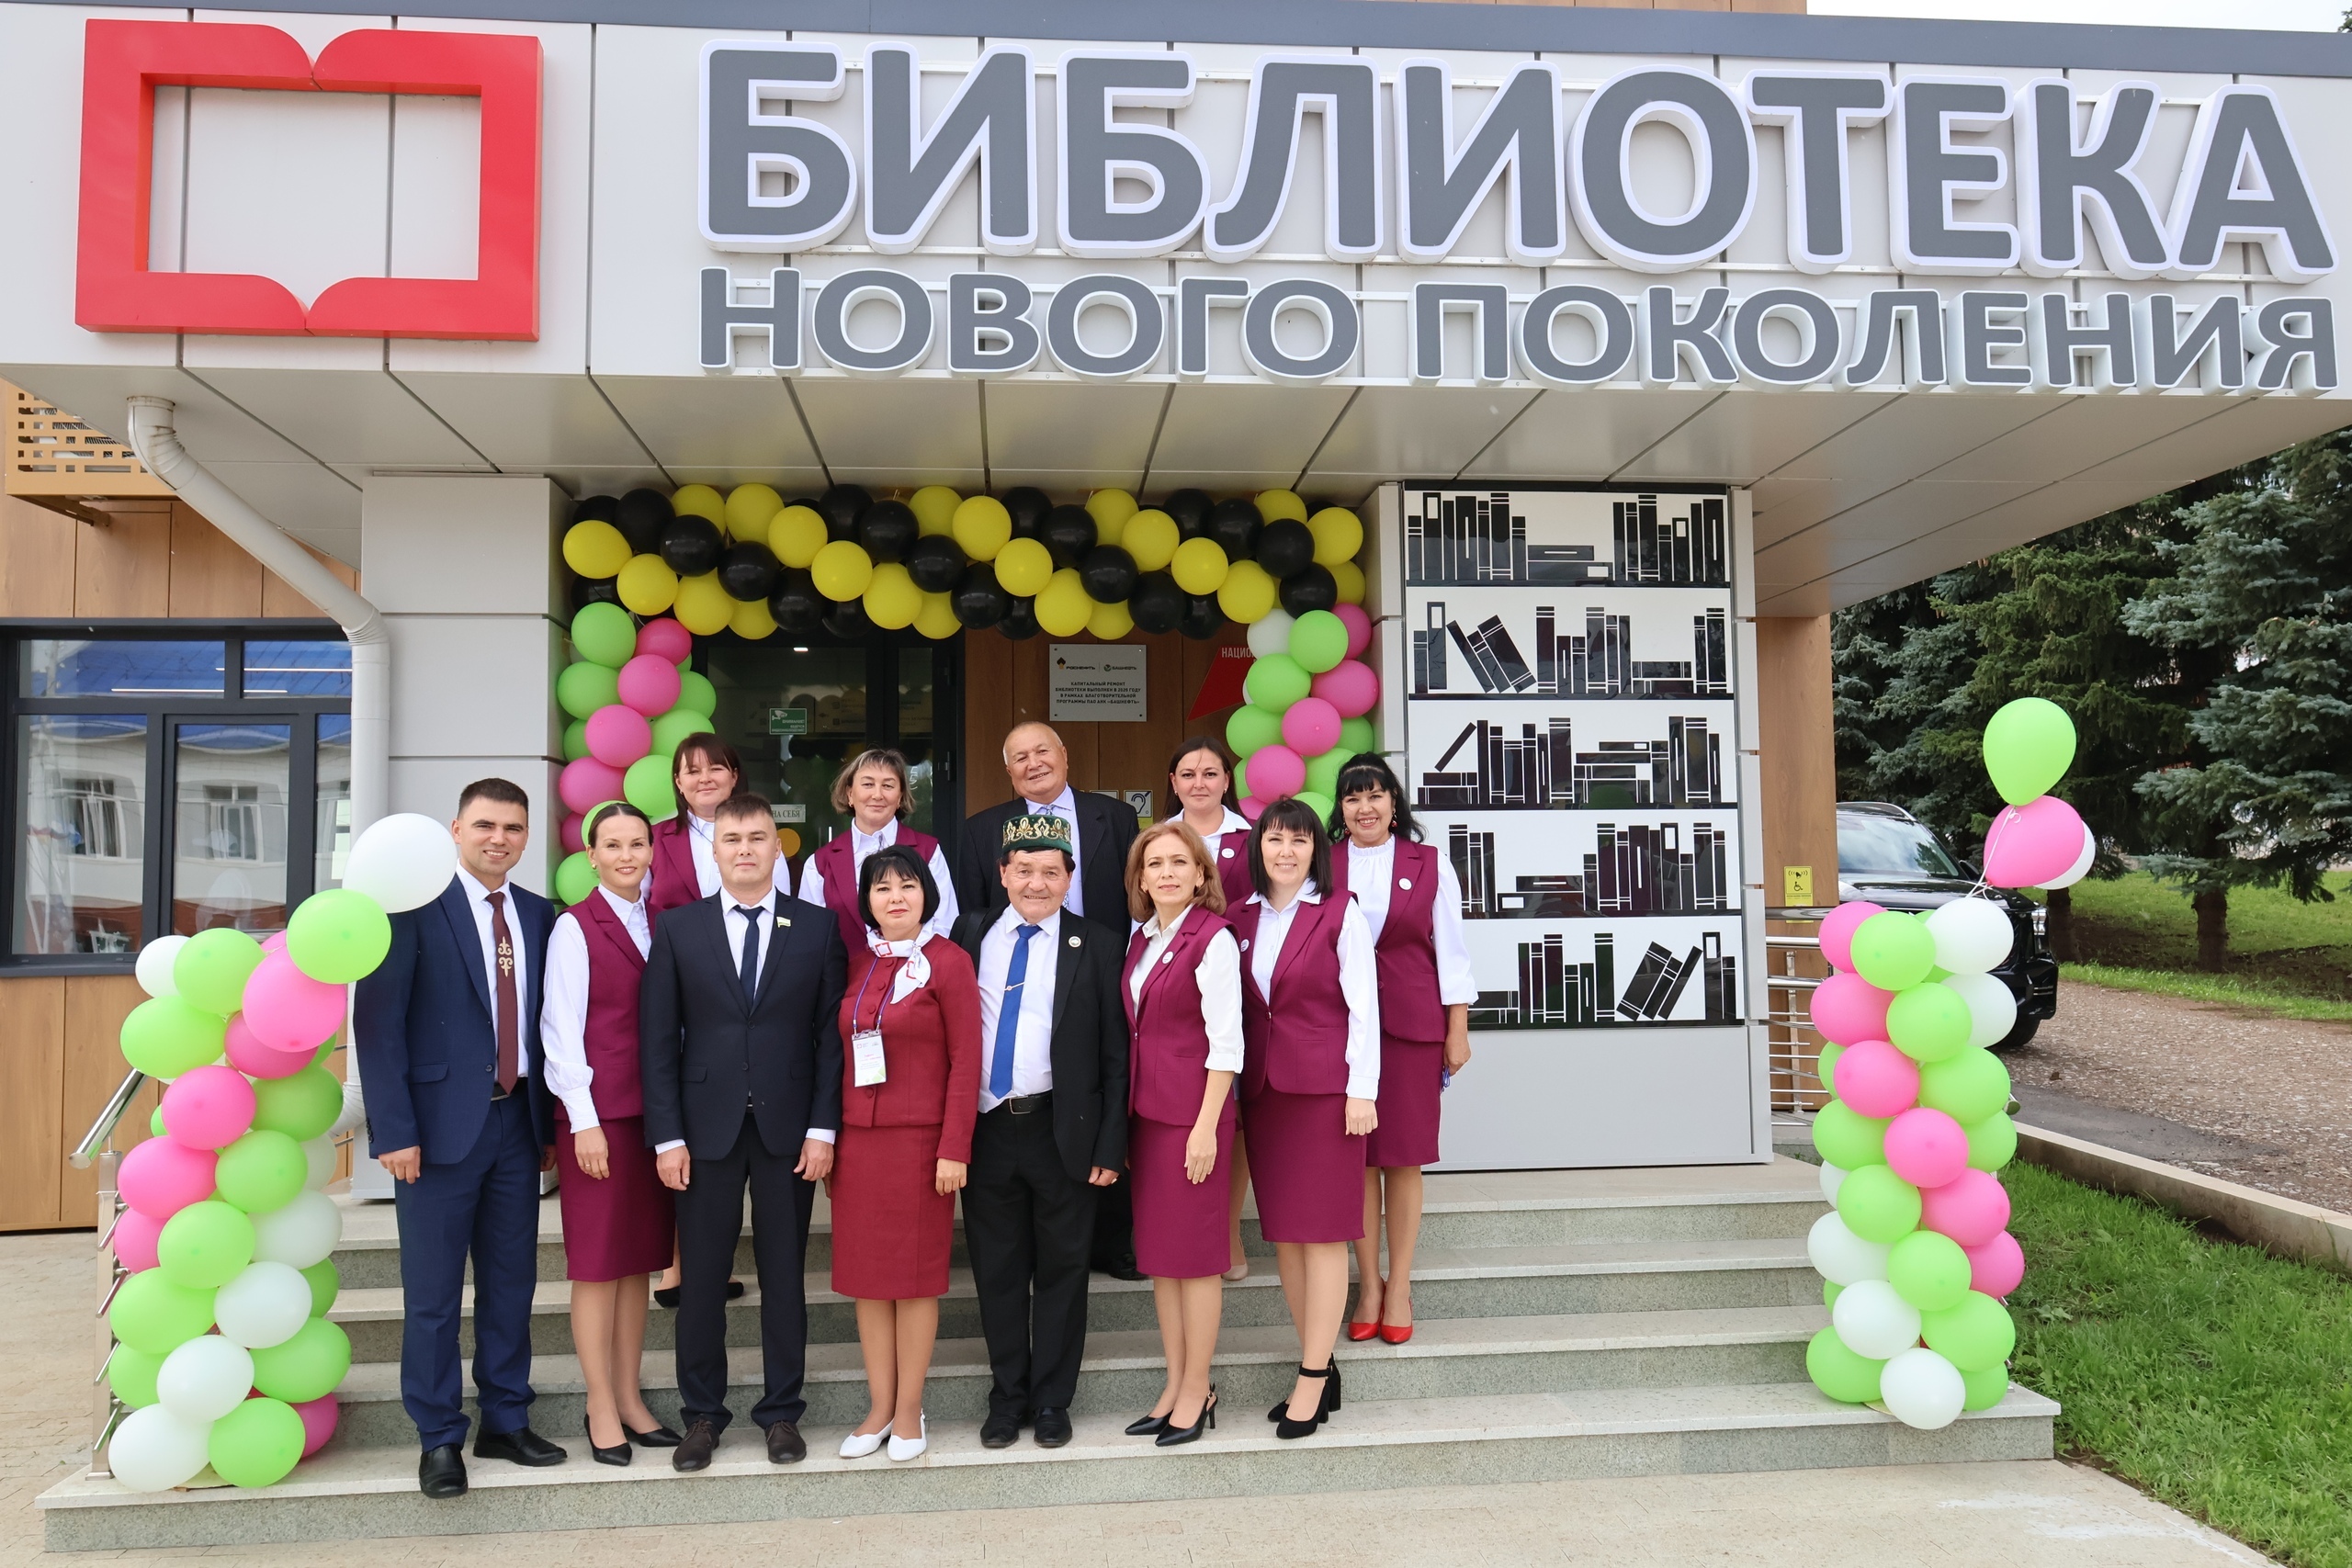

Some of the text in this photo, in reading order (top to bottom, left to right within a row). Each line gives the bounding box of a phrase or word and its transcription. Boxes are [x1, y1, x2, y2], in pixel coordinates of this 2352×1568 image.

[699, 39, 2339, 275] БИБЛИОТЕКА
[699, 266, 2340, 393] НОВОГО ПОКОЛЕНИЯ
[1222, 647, 1253, 659] НАЦИО
[783, 809, 800, 818] СЕБЯ
